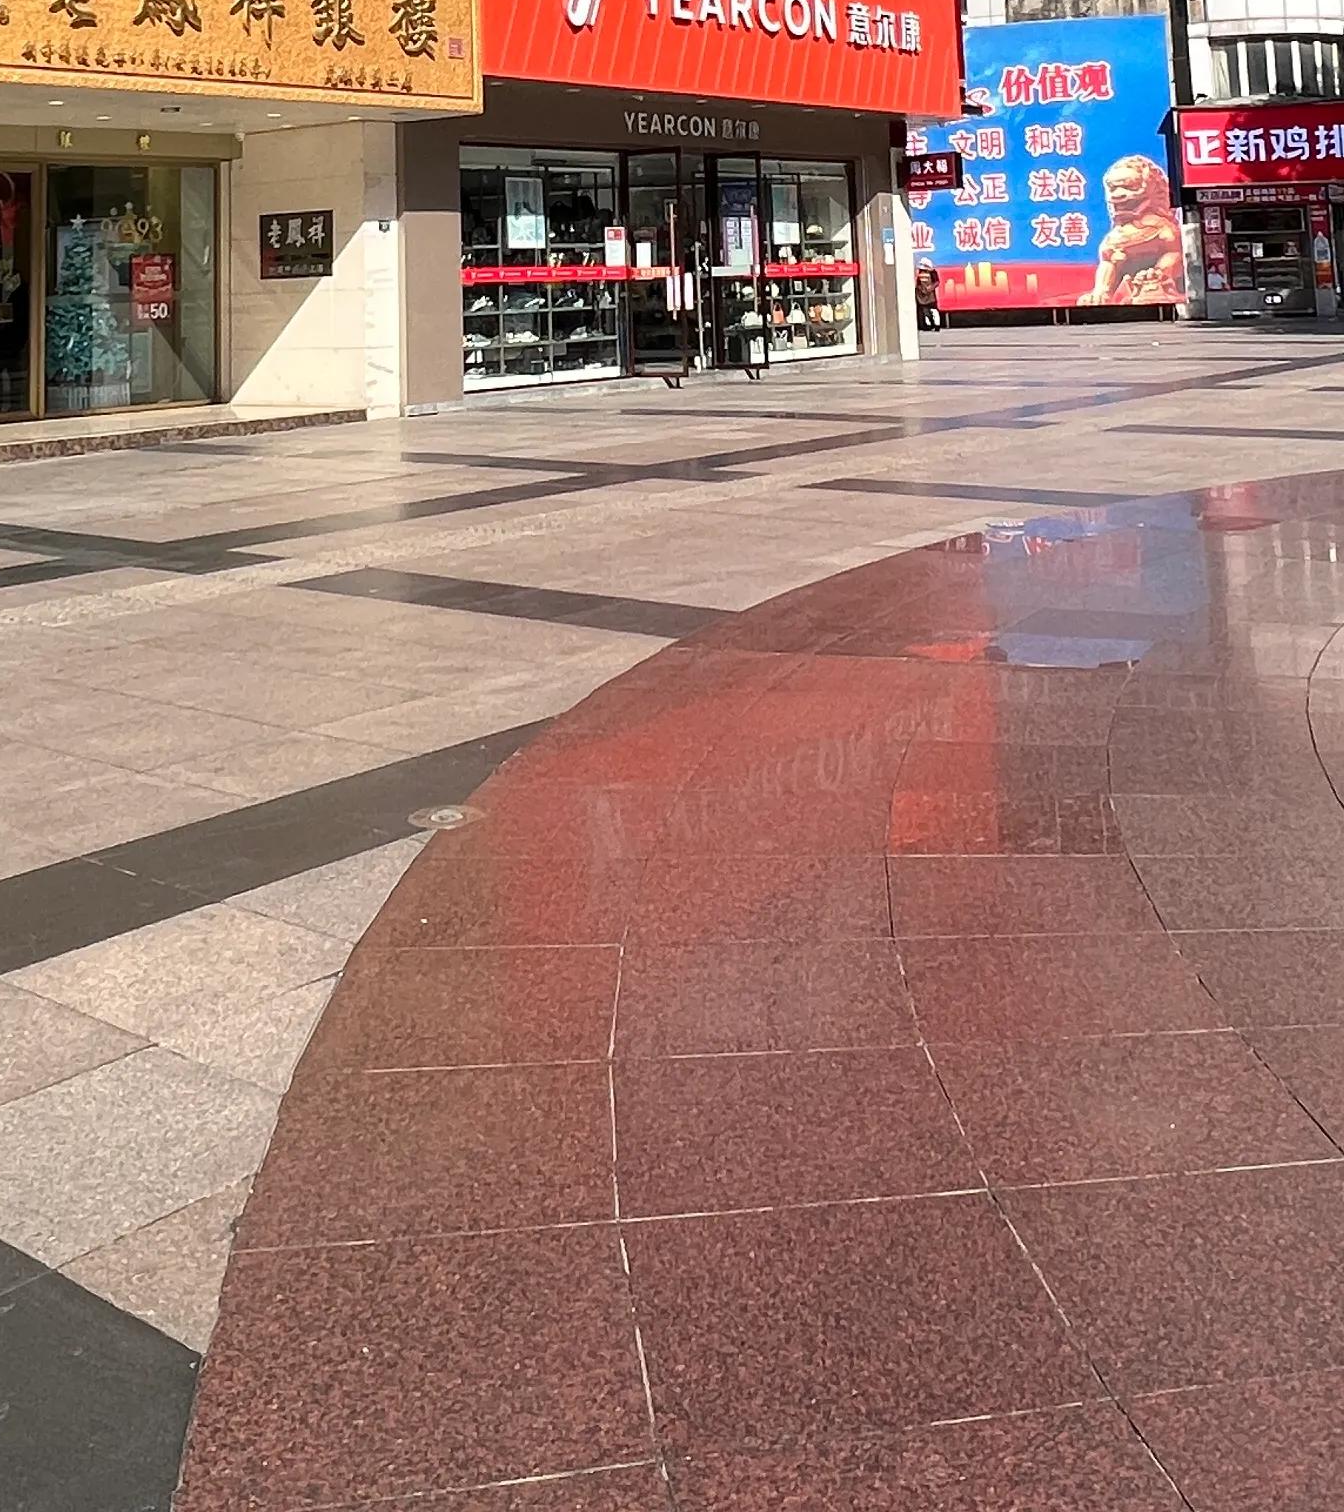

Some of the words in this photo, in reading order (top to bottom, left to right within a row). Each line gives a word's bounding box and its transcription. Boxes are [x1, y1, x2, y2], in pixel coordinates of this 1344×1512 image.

[846, 1, 924, 54] 意尔康
[1002, 62, 1112, 103] 价值观
[624, 112, 716, 138] YEARCON
[949, 128, 1005, 159] 文明
[1025, 122, 1082, 157] 和谐
[955, 173, 1008, 205] 公正
[1028, 167, 1086, 201] 法治
[954, 216, 1010, 251] 诚信
[1031, 213, 1089, 247] 友善
